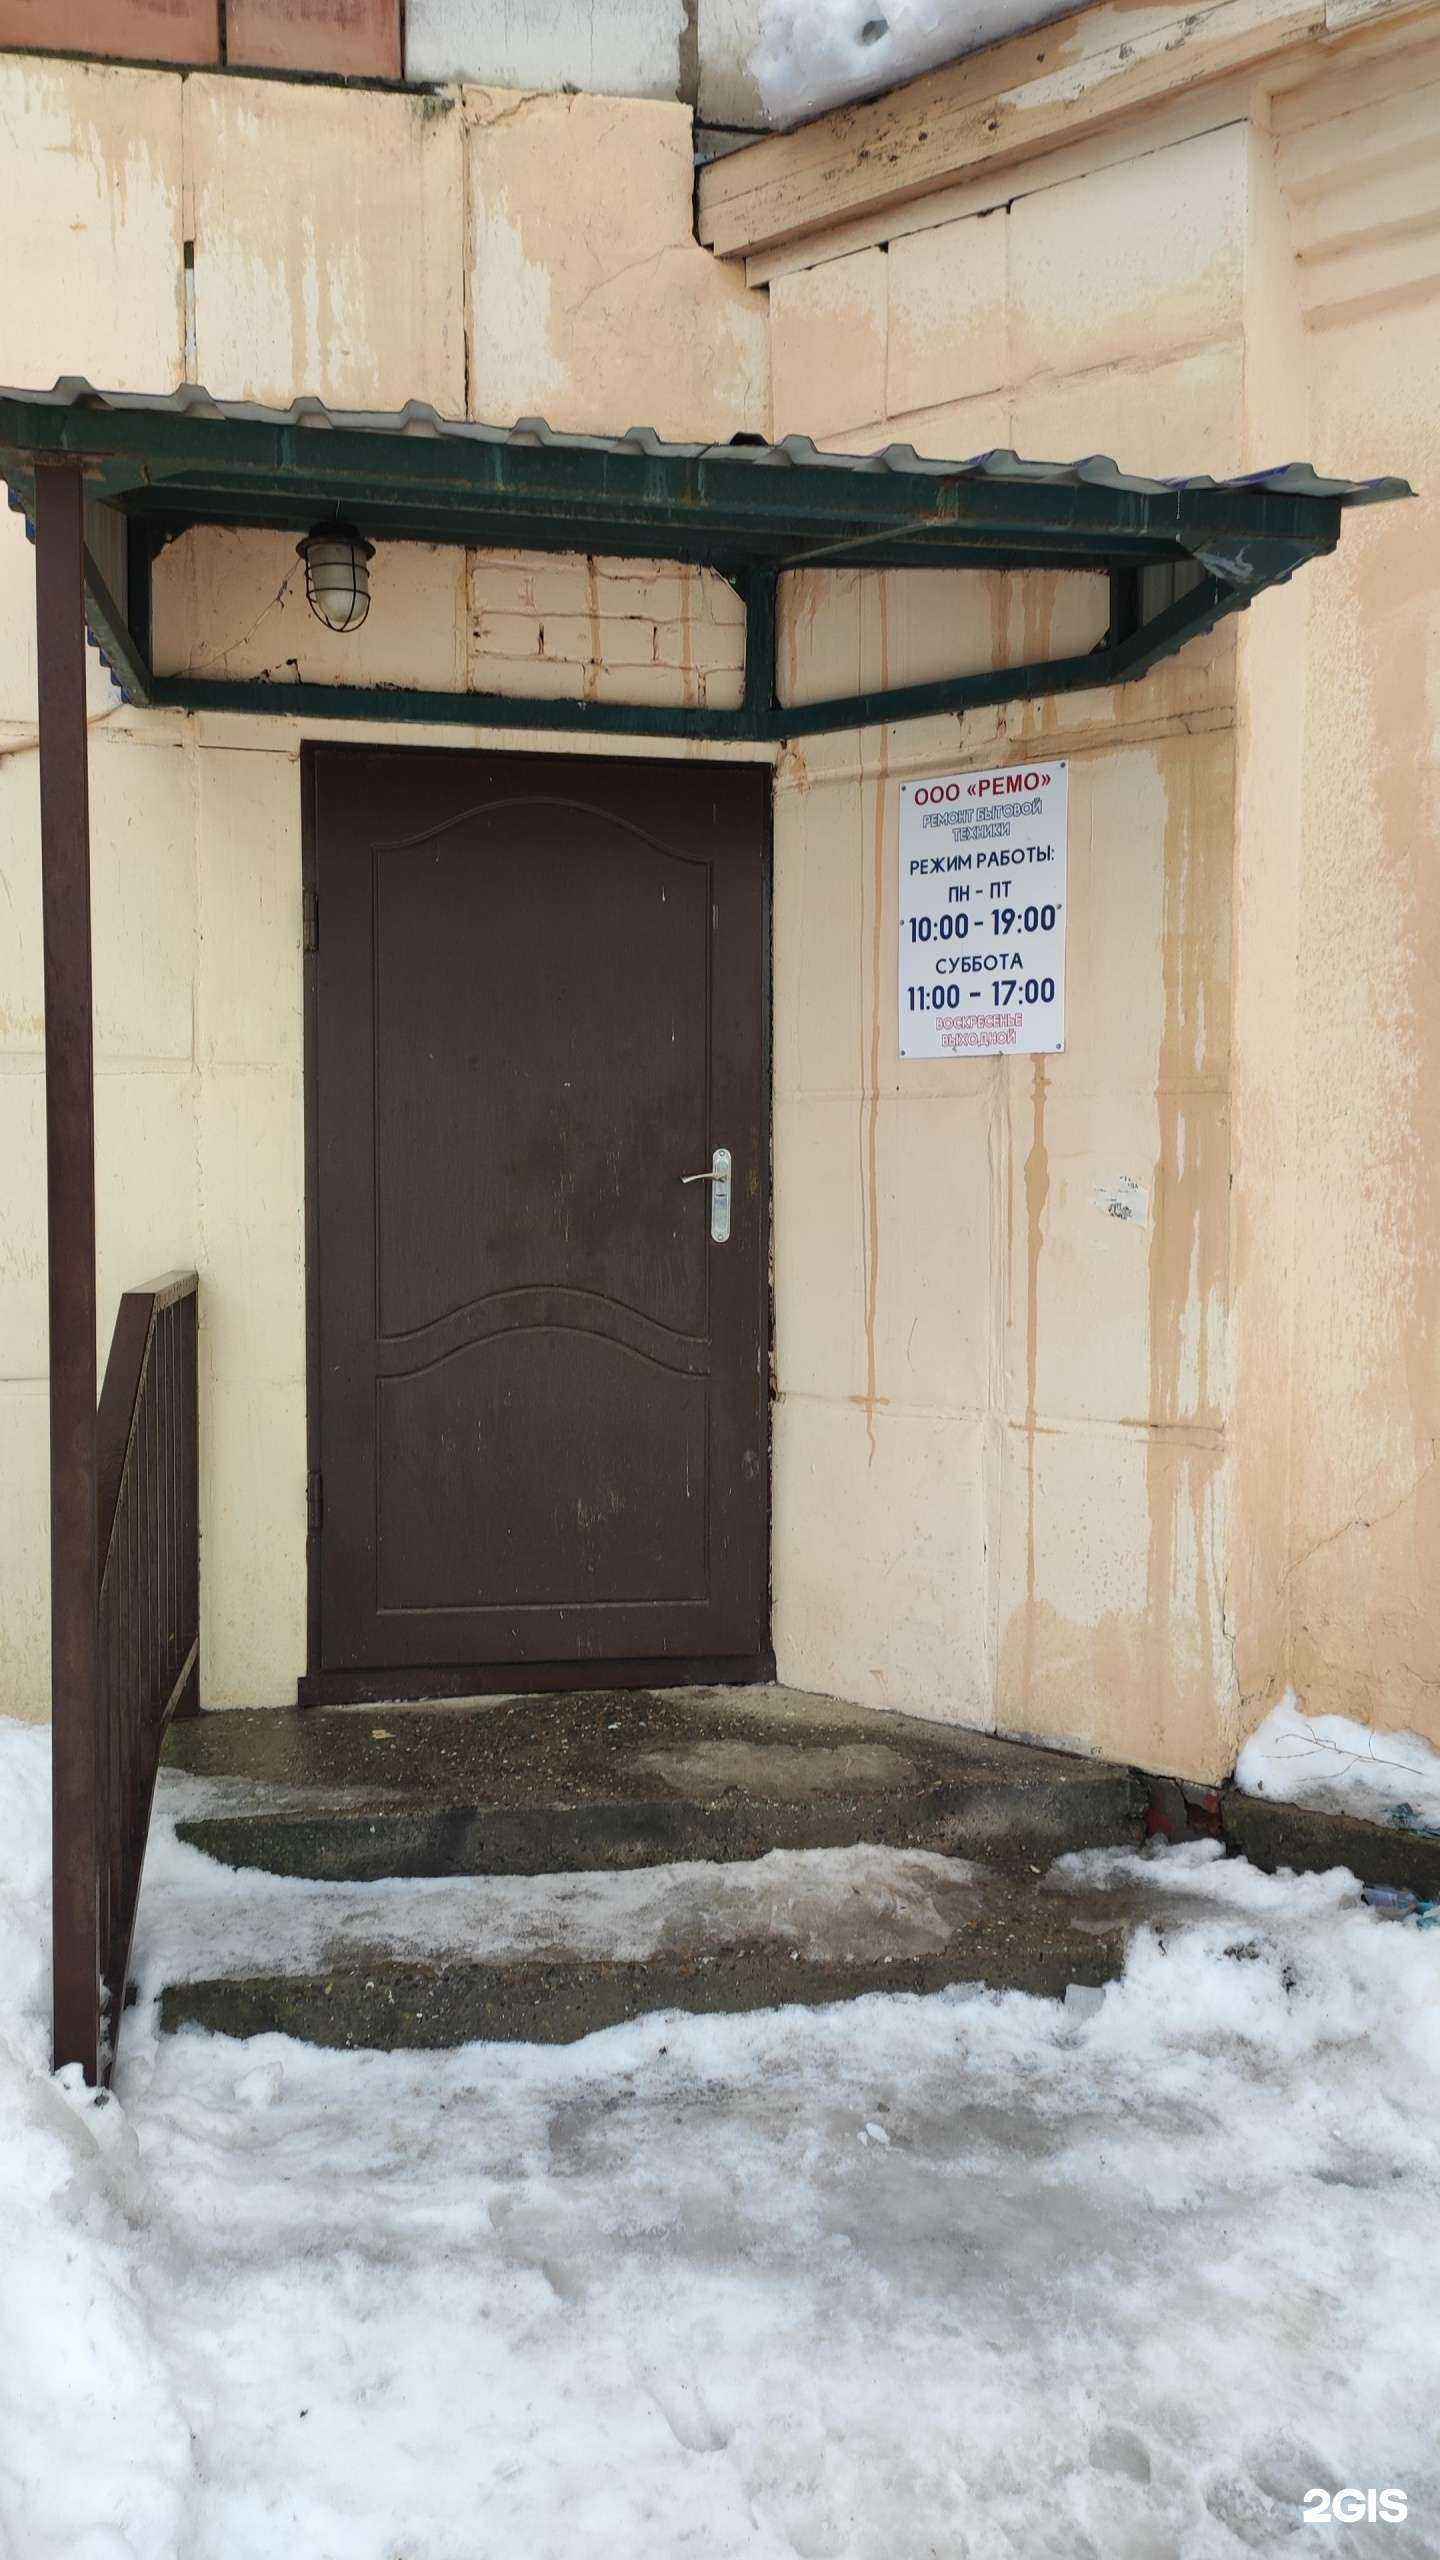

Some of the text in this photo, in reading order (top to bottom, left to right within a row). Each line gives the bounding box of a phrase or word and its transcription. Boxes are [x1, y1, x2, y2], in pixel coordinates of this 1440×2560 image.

[915, 772, 1051, 806] ООО «РЕМО»
[923, 798, 1042, 829] РЕМОНТ БЫТОВОЙ
[952, 822, 1010, 843] ТЕХНИКИ
[909, 845, 1055, 876] РЕЖИМ РАБОТЫ:
[949, 885, 969, 903] ПН
[990, 881, 1012, 899] ПТ
[909, 913, 968, 943] 10:00
[992, 905, 1056, 935] 19:00
[936, 952, 1023, 974] СУББОТА
[908, 984, 960, 1011] 11:00
[992, 977, 1055, 1007] 17:00
[936, 1013, 1023, 1030] ВОСКРЕСЕНЬЕ
[941, 1031, 1017, 1048] ВЫХОДНОЙ
